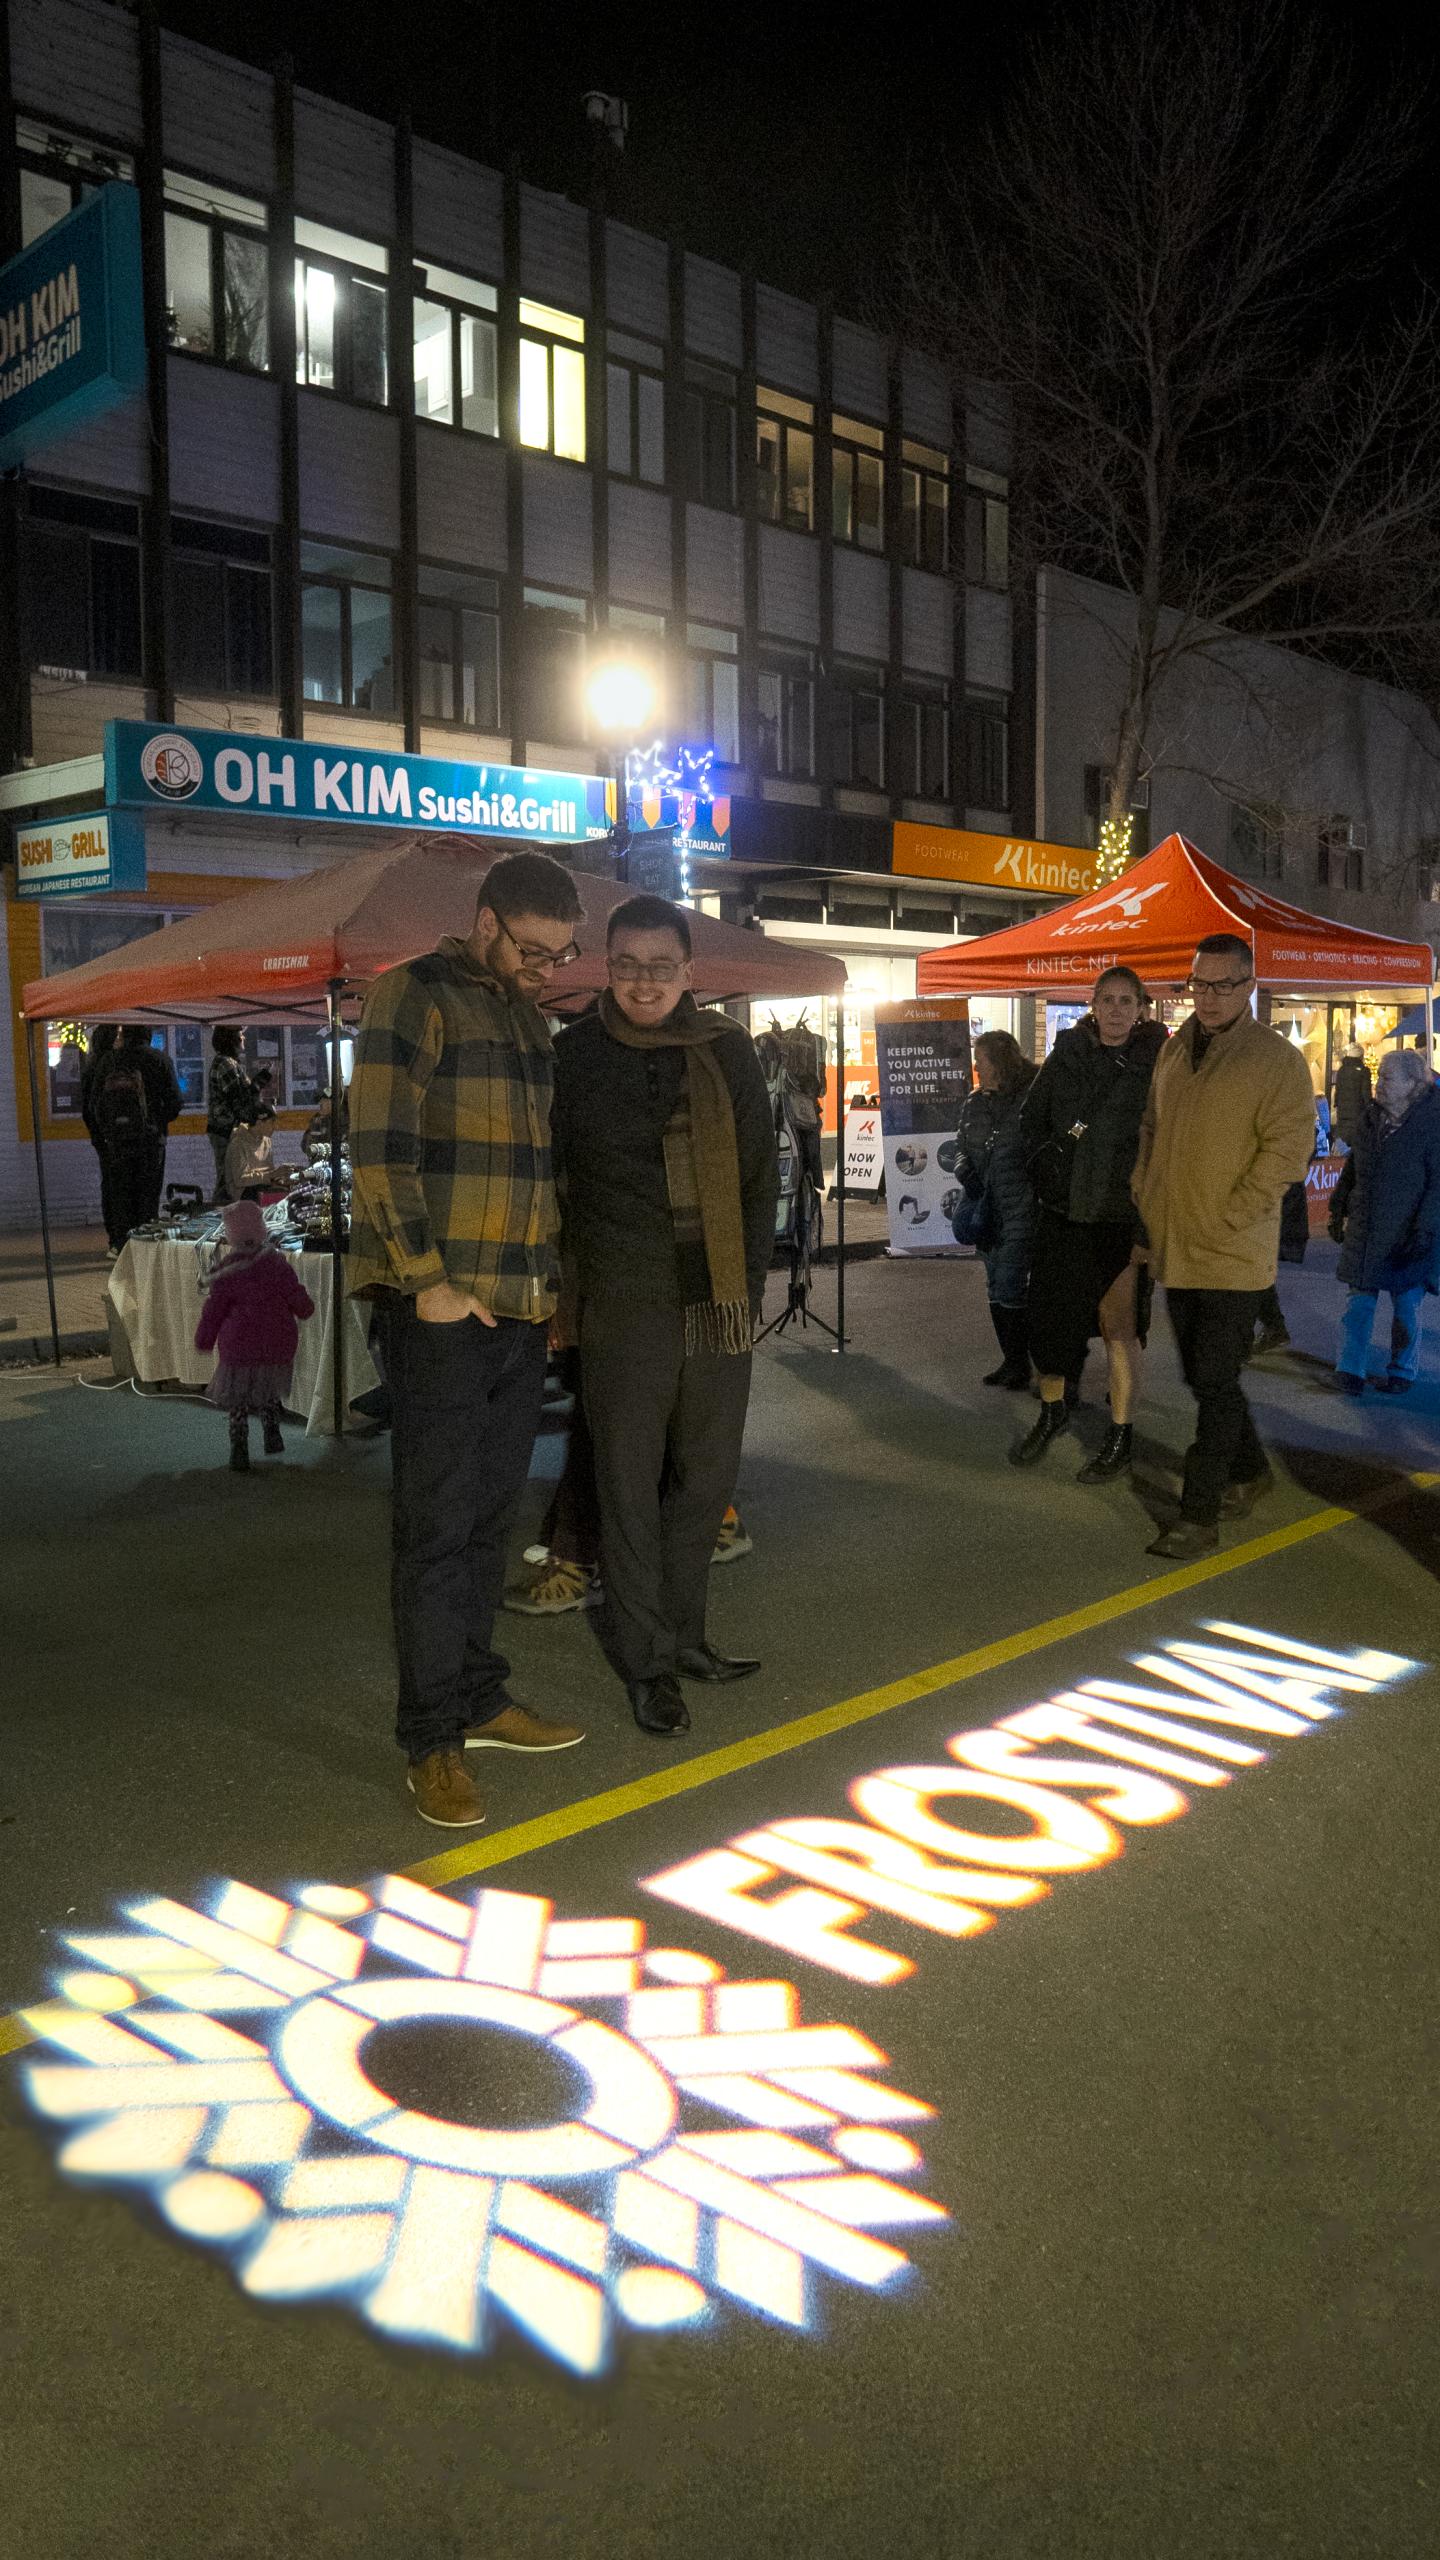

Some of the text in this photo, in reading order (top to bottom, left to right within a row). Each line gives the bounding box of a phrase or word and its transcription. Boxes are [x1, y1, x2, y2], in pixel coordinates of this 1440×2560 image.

[31, 263, 80, 341] KIM
[0, 315, 81, 400] ushi&Grill
[214, 748, 296, 807] OH
[313, 758, 413, 818] KIM
[418, 786, 576, 834] Sushi&Grill
[21, 829, 106, 867] SUSHI GRILL
[672, 837, 726, 852] RESTAURANT
[914, 844, 1091, 891] FOOTWEAR kintec
[70, 874, 111, 889] RESTAURANT
[1049, 918, 1149, 937] kintec
[263, 955, 309, 971] CRAFTSMAN
[1272, 950, 1306, 961] FOOTWEAR
[1026, 953, 1120, 975] KINTEC.NET
[887, 1046, 934, 1057] KEEPING
[887, 1058, 951, 1070] YOU ACTIVE
[888, 1073, 906, 1082] ON
[908, 1071, 938, 1081] YOUR
[889, 1084, 940, 1095] FOR LIFE.
[856, 1133, 876, 1142] kintec
[848, 1152, 876, 1164] NOW
[843, 1166, 873, 1178] OPEN
[1321, 1164, 1343, 1189] kin
[638, 1619, 1424, 1985] FROSTIVAL
